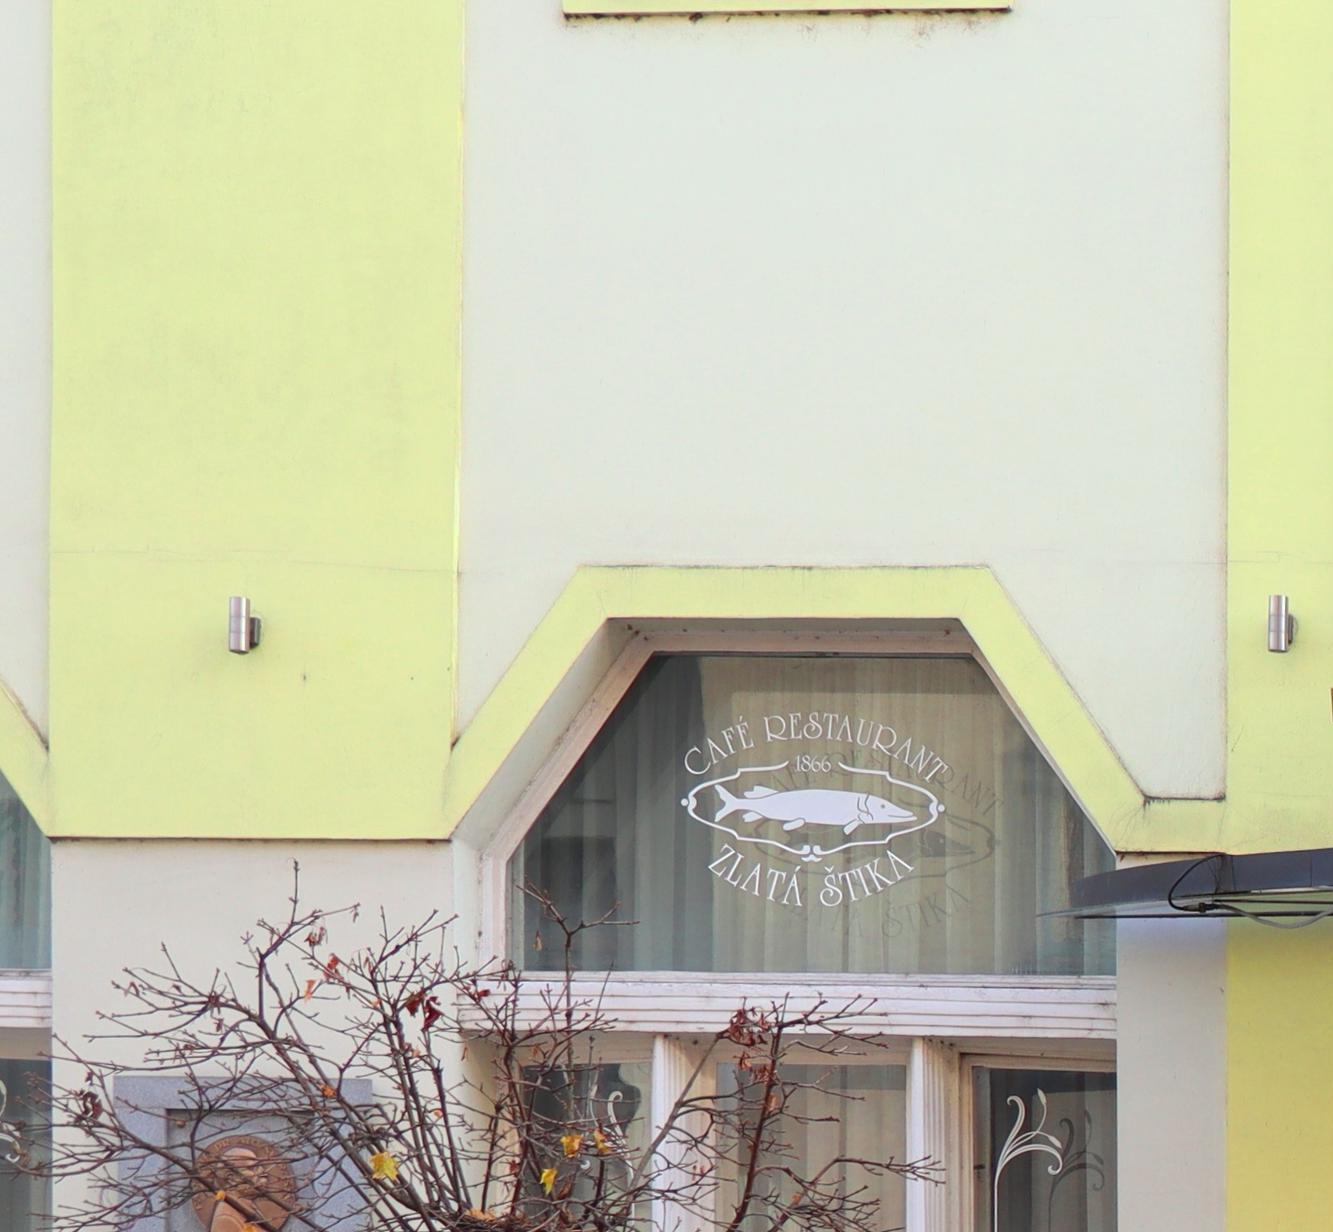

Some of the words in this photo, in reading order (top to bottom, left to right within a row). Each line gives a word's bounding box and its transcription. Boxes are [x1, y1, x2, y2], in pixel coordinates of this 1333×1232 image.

[684, 715, 755, 775] CAFÉ
[763, 711, 949, 784] RESTAURANT
[794, 754, 832, 773] 1866
[707, 843, 803, 906] ZLATÁ
[819, 849, 915, 907] ŠTIKA
